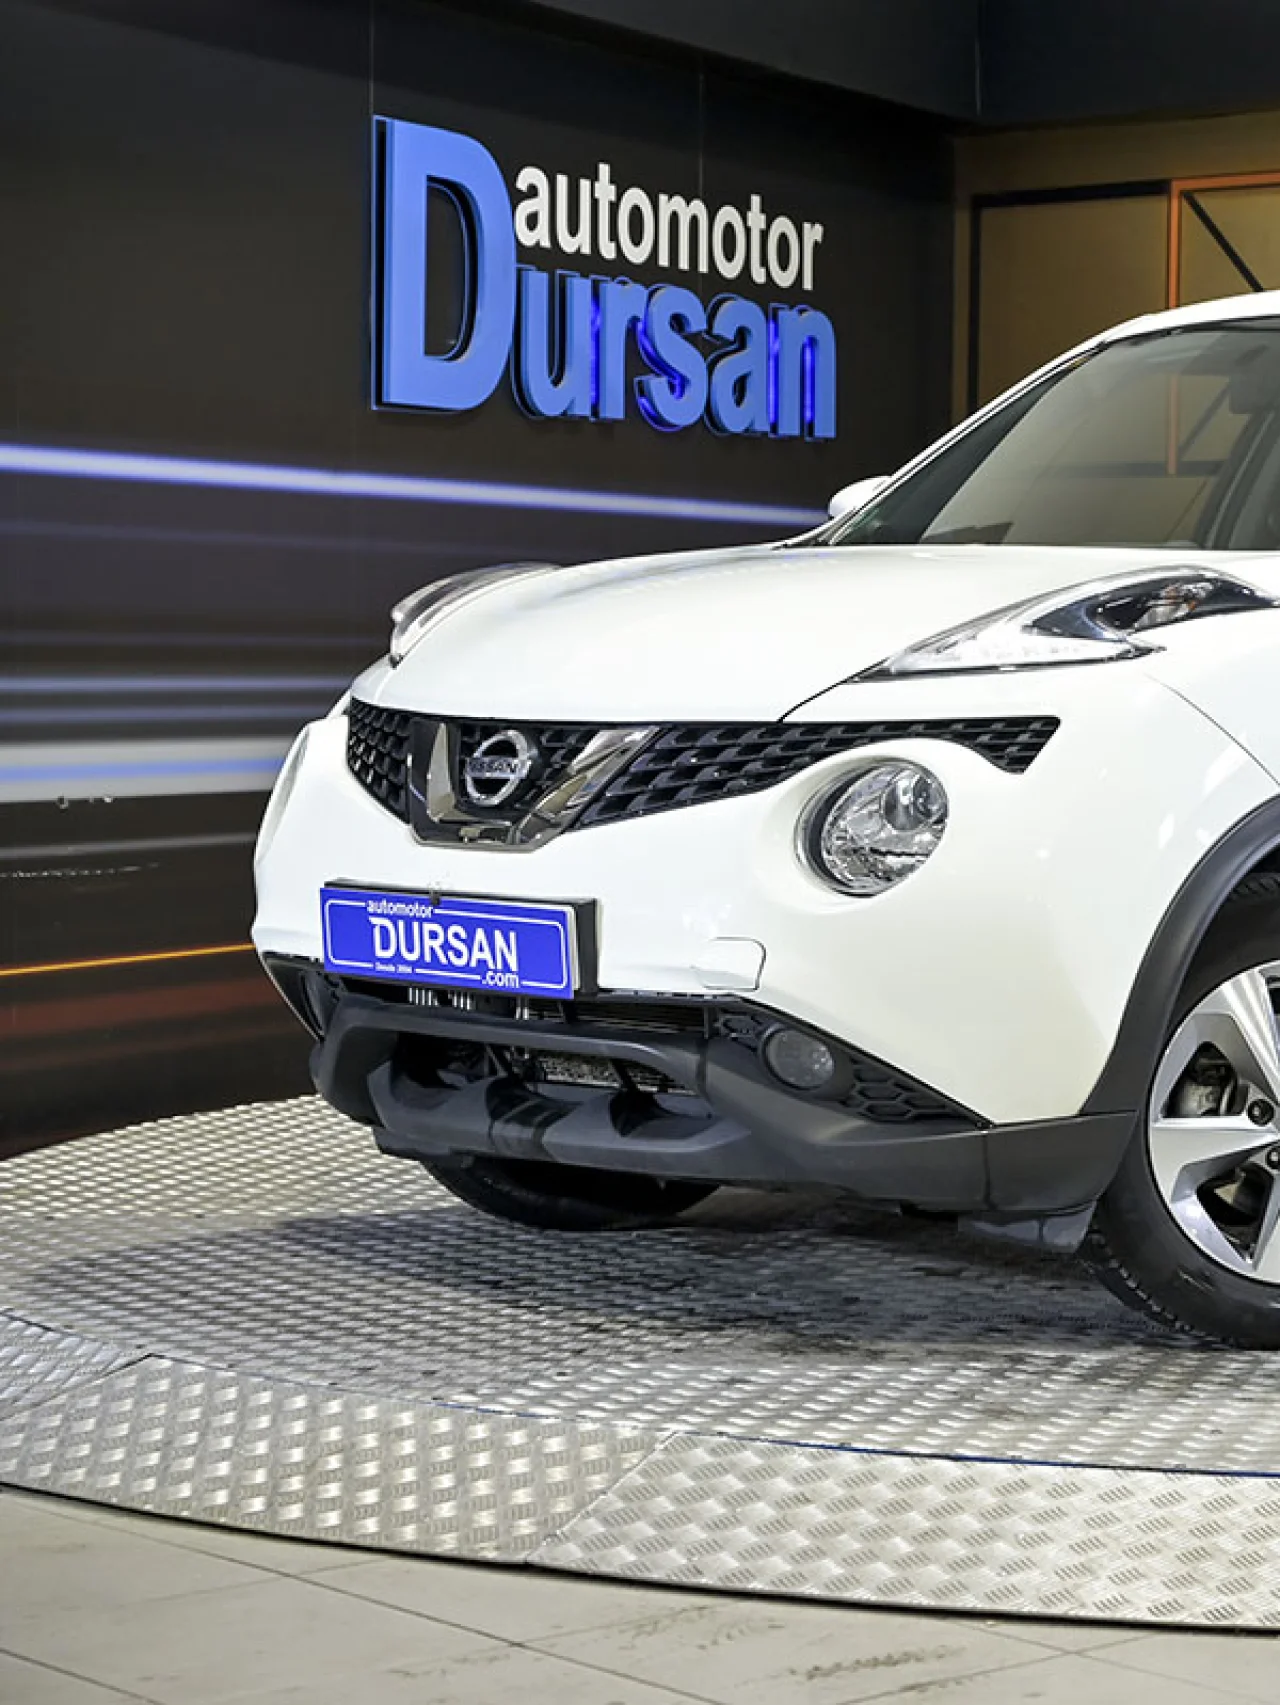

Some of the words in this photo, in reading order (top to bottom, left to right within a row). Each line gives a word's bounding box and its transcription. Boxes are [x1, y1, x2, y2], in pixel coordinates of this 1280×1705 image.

[514, 162, 823, 290] automotor
[371, 114, 837, 441] Dursan
[366, 898, 433, 918] automotor
[368, 916, 518, 972] DURSAN
[481, 970, 520, 988] .com
